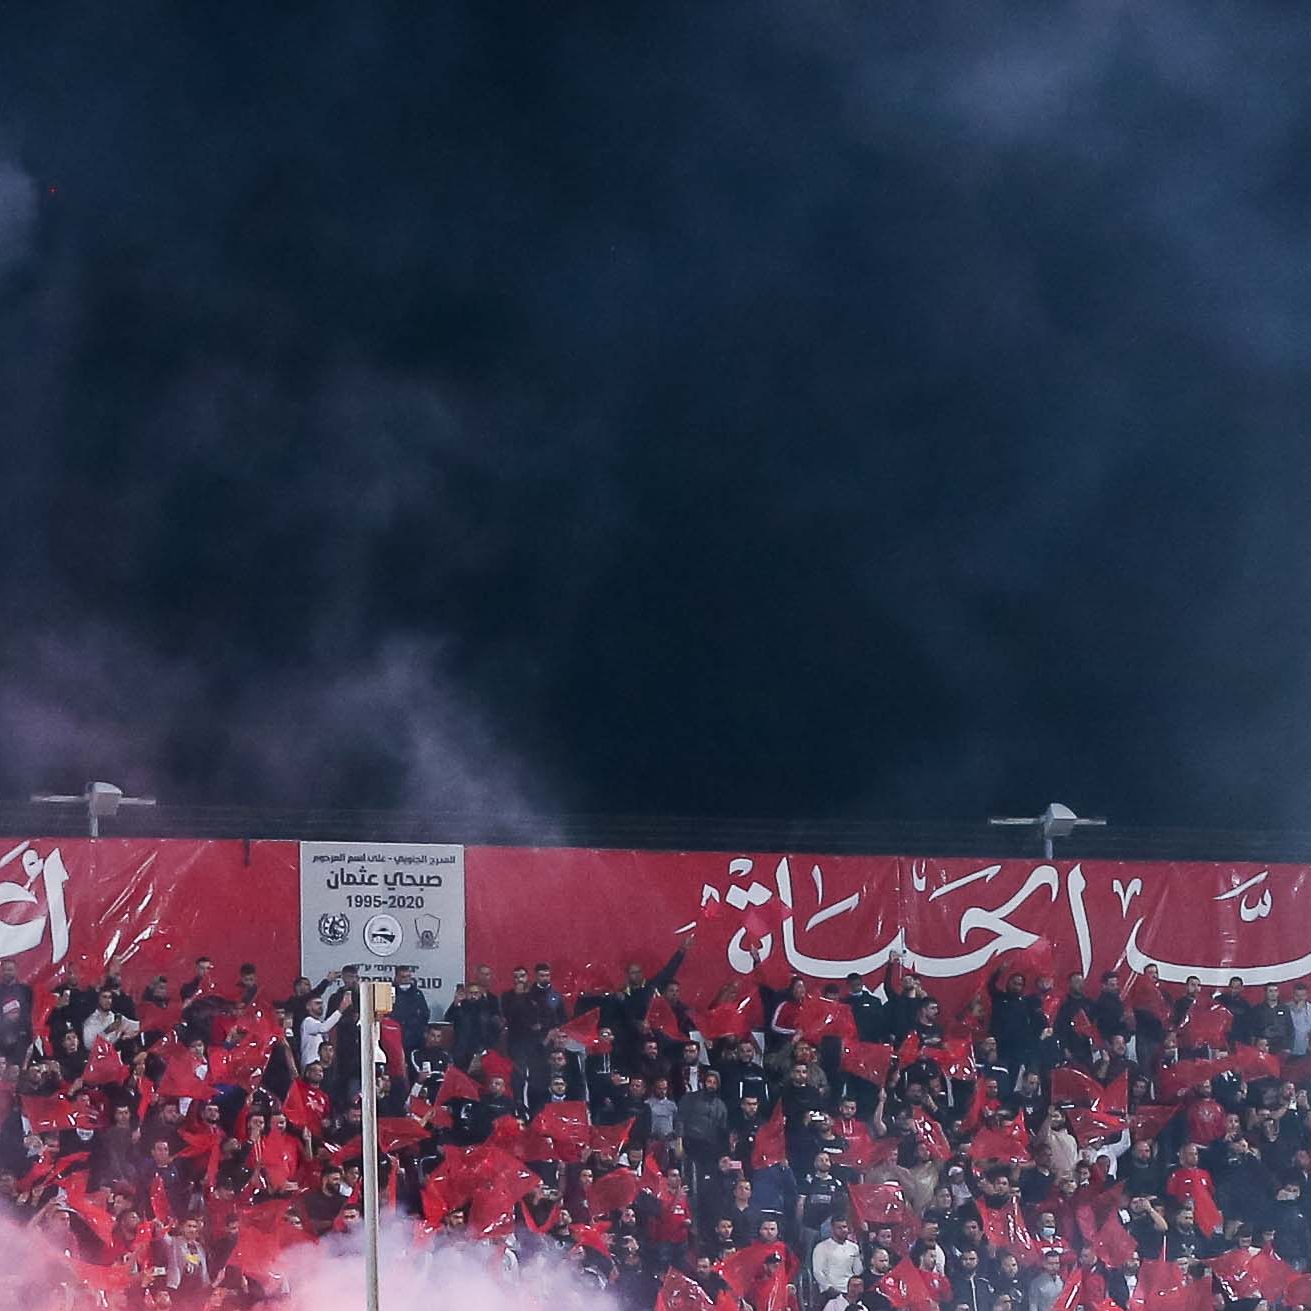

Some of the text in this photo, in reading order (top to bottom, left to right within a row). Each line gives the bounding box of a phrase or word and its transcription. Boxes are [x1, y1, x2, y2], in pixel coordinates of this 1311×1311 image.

[326, 866, 443, 891] صبحي عثمان
[345, 895, 424, 909] 1995-2020
